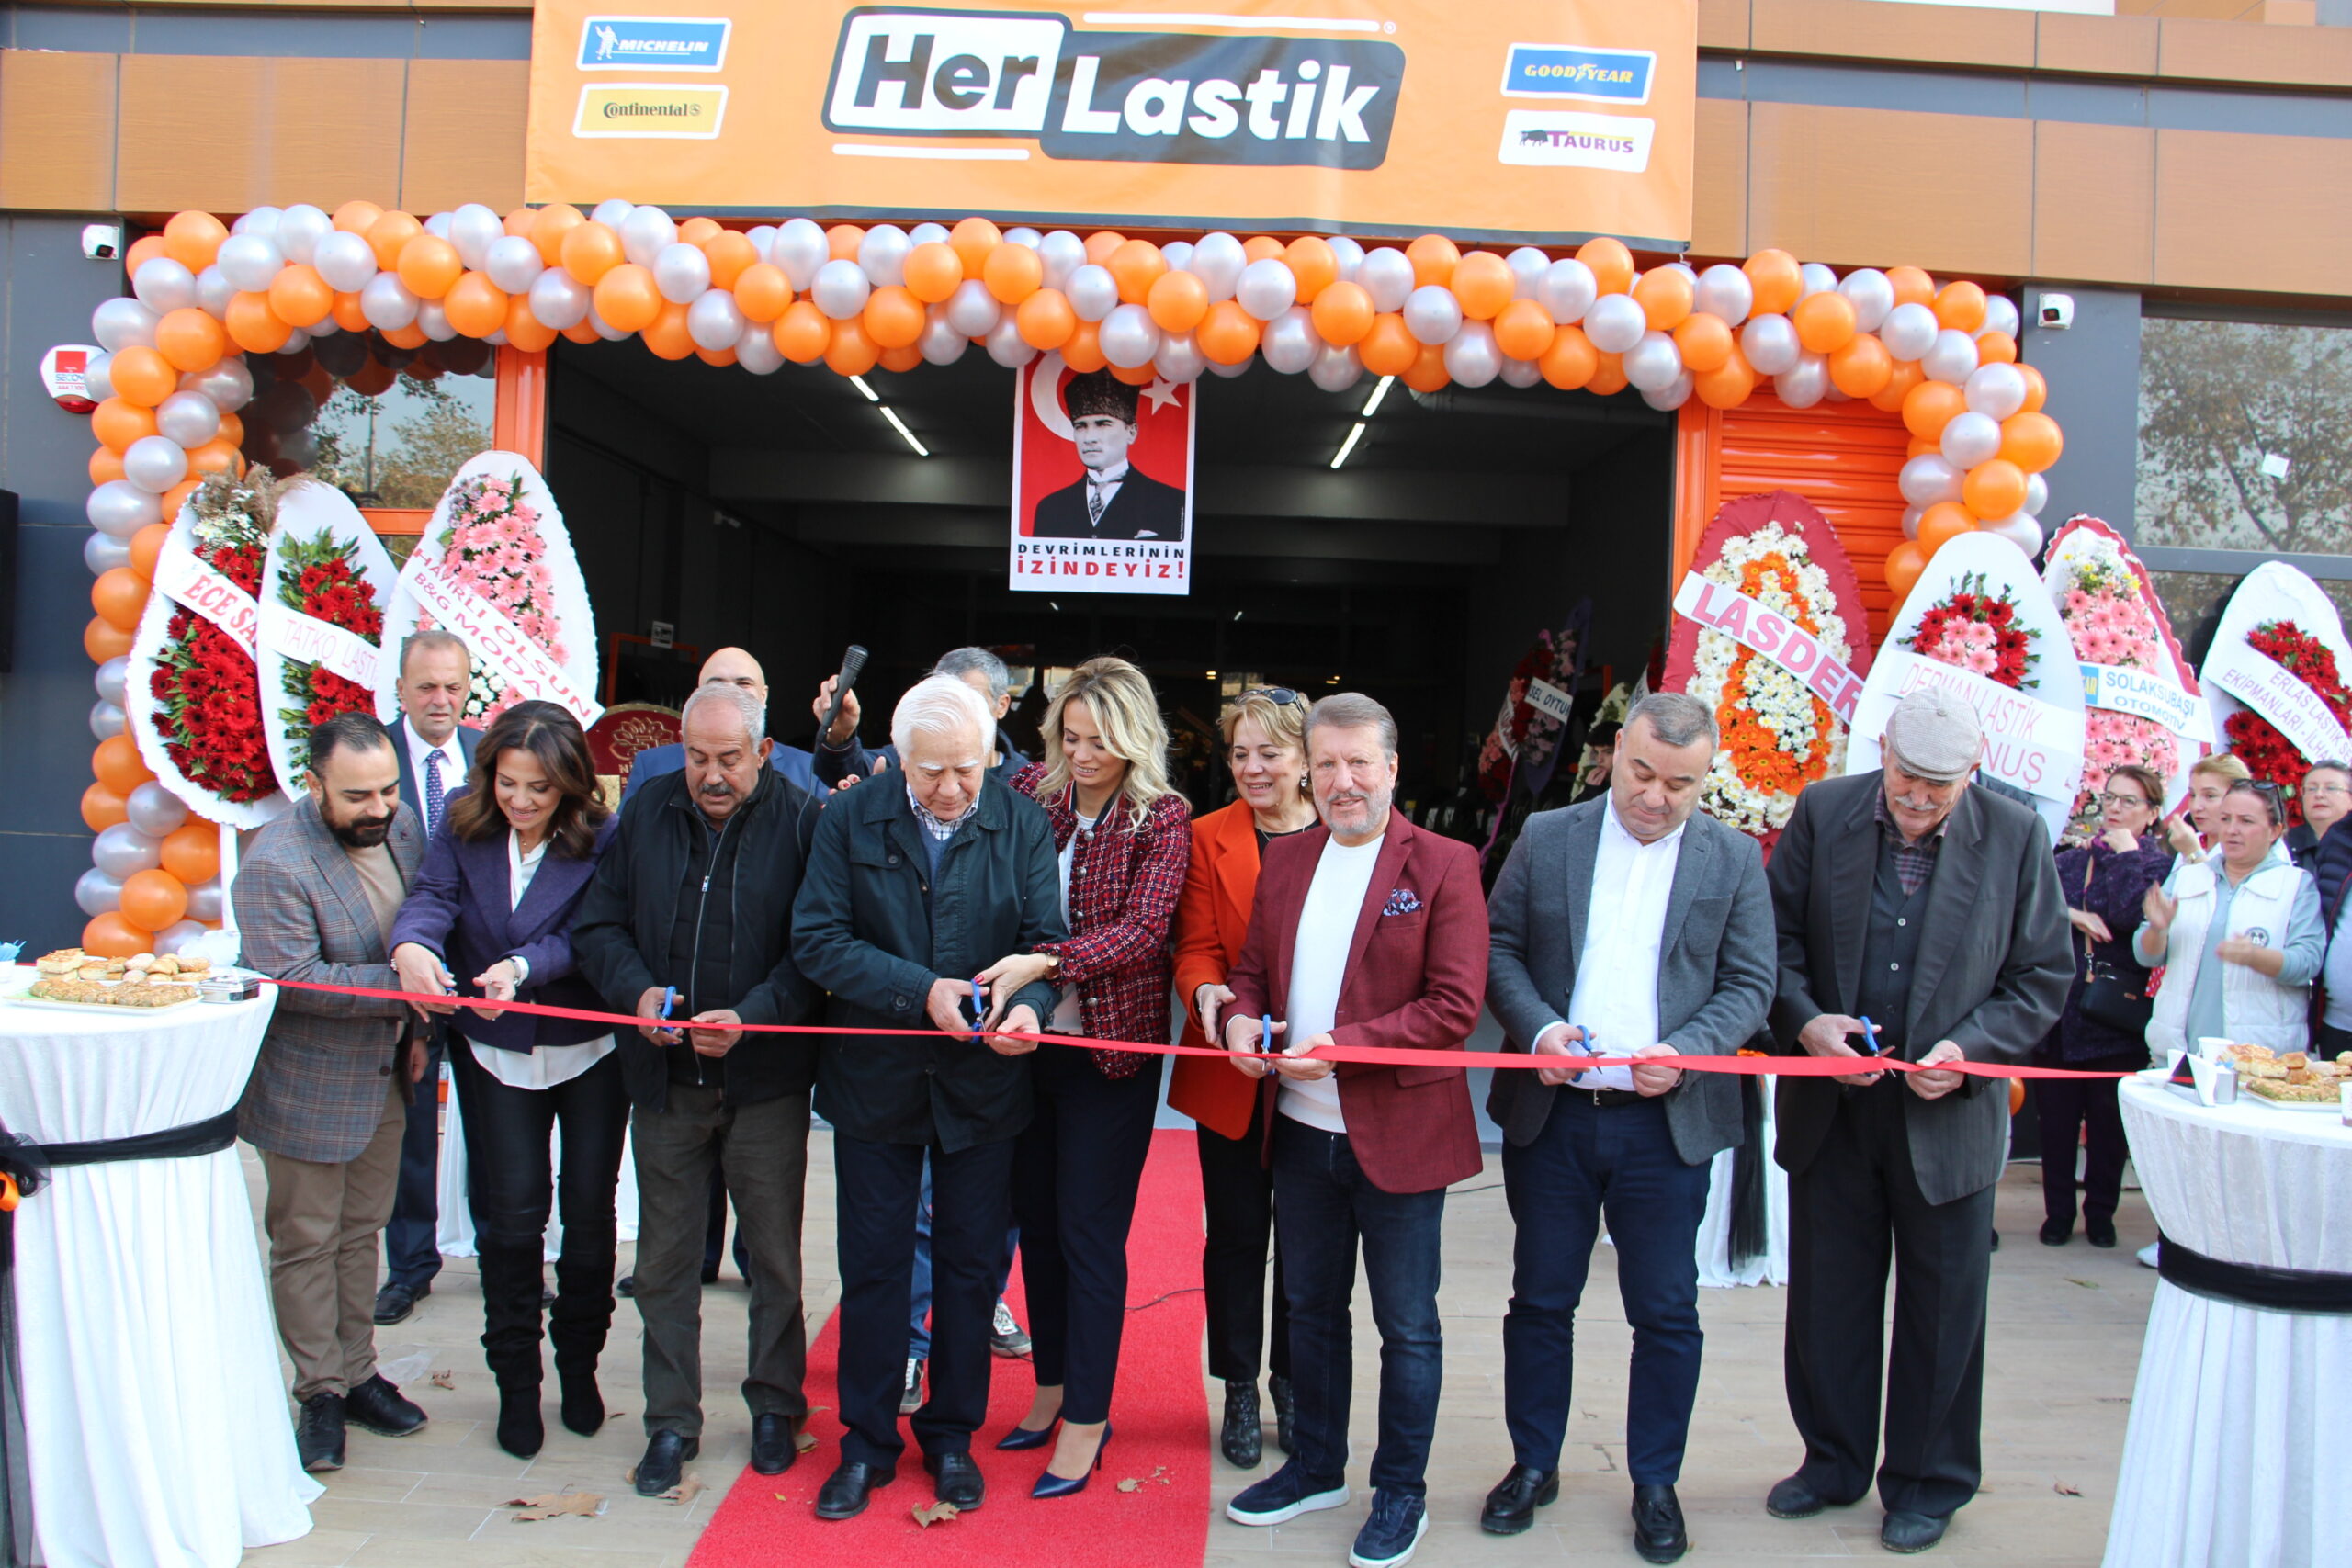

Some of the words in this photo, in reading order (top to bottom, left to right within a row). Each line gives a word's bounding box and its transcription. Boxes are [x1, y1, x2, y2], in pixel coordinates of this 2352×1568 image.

[618, 39, 709, 52] MICHELIN
[853, 33, 1040, 111] Her
[1060, 54, 1380, 143] Lastik
[1524, 63, 1634, 84] GOODYEAR
[603, 102, 688, 118] Continental
[1547, 130, 1634, 153] TAURUS
[1017, 555, 1184, 579] İZİNDEYİZ!
[1018, 542, 1185, 559] DEVRİMLERİNİN
[414, 572, 451, 611] B&G
[182, 574, 239, 616] ECE
[230, 606, 258, 649] SA
[282, 618, 337, 660] TATKO
[1691, 583, 1865, 723] LASDER
[494, 625, 591, 717] OLSUN
[2269, 671, 2312, 708] ERLAS
[2304, 728, 2334, 761] İLHA
